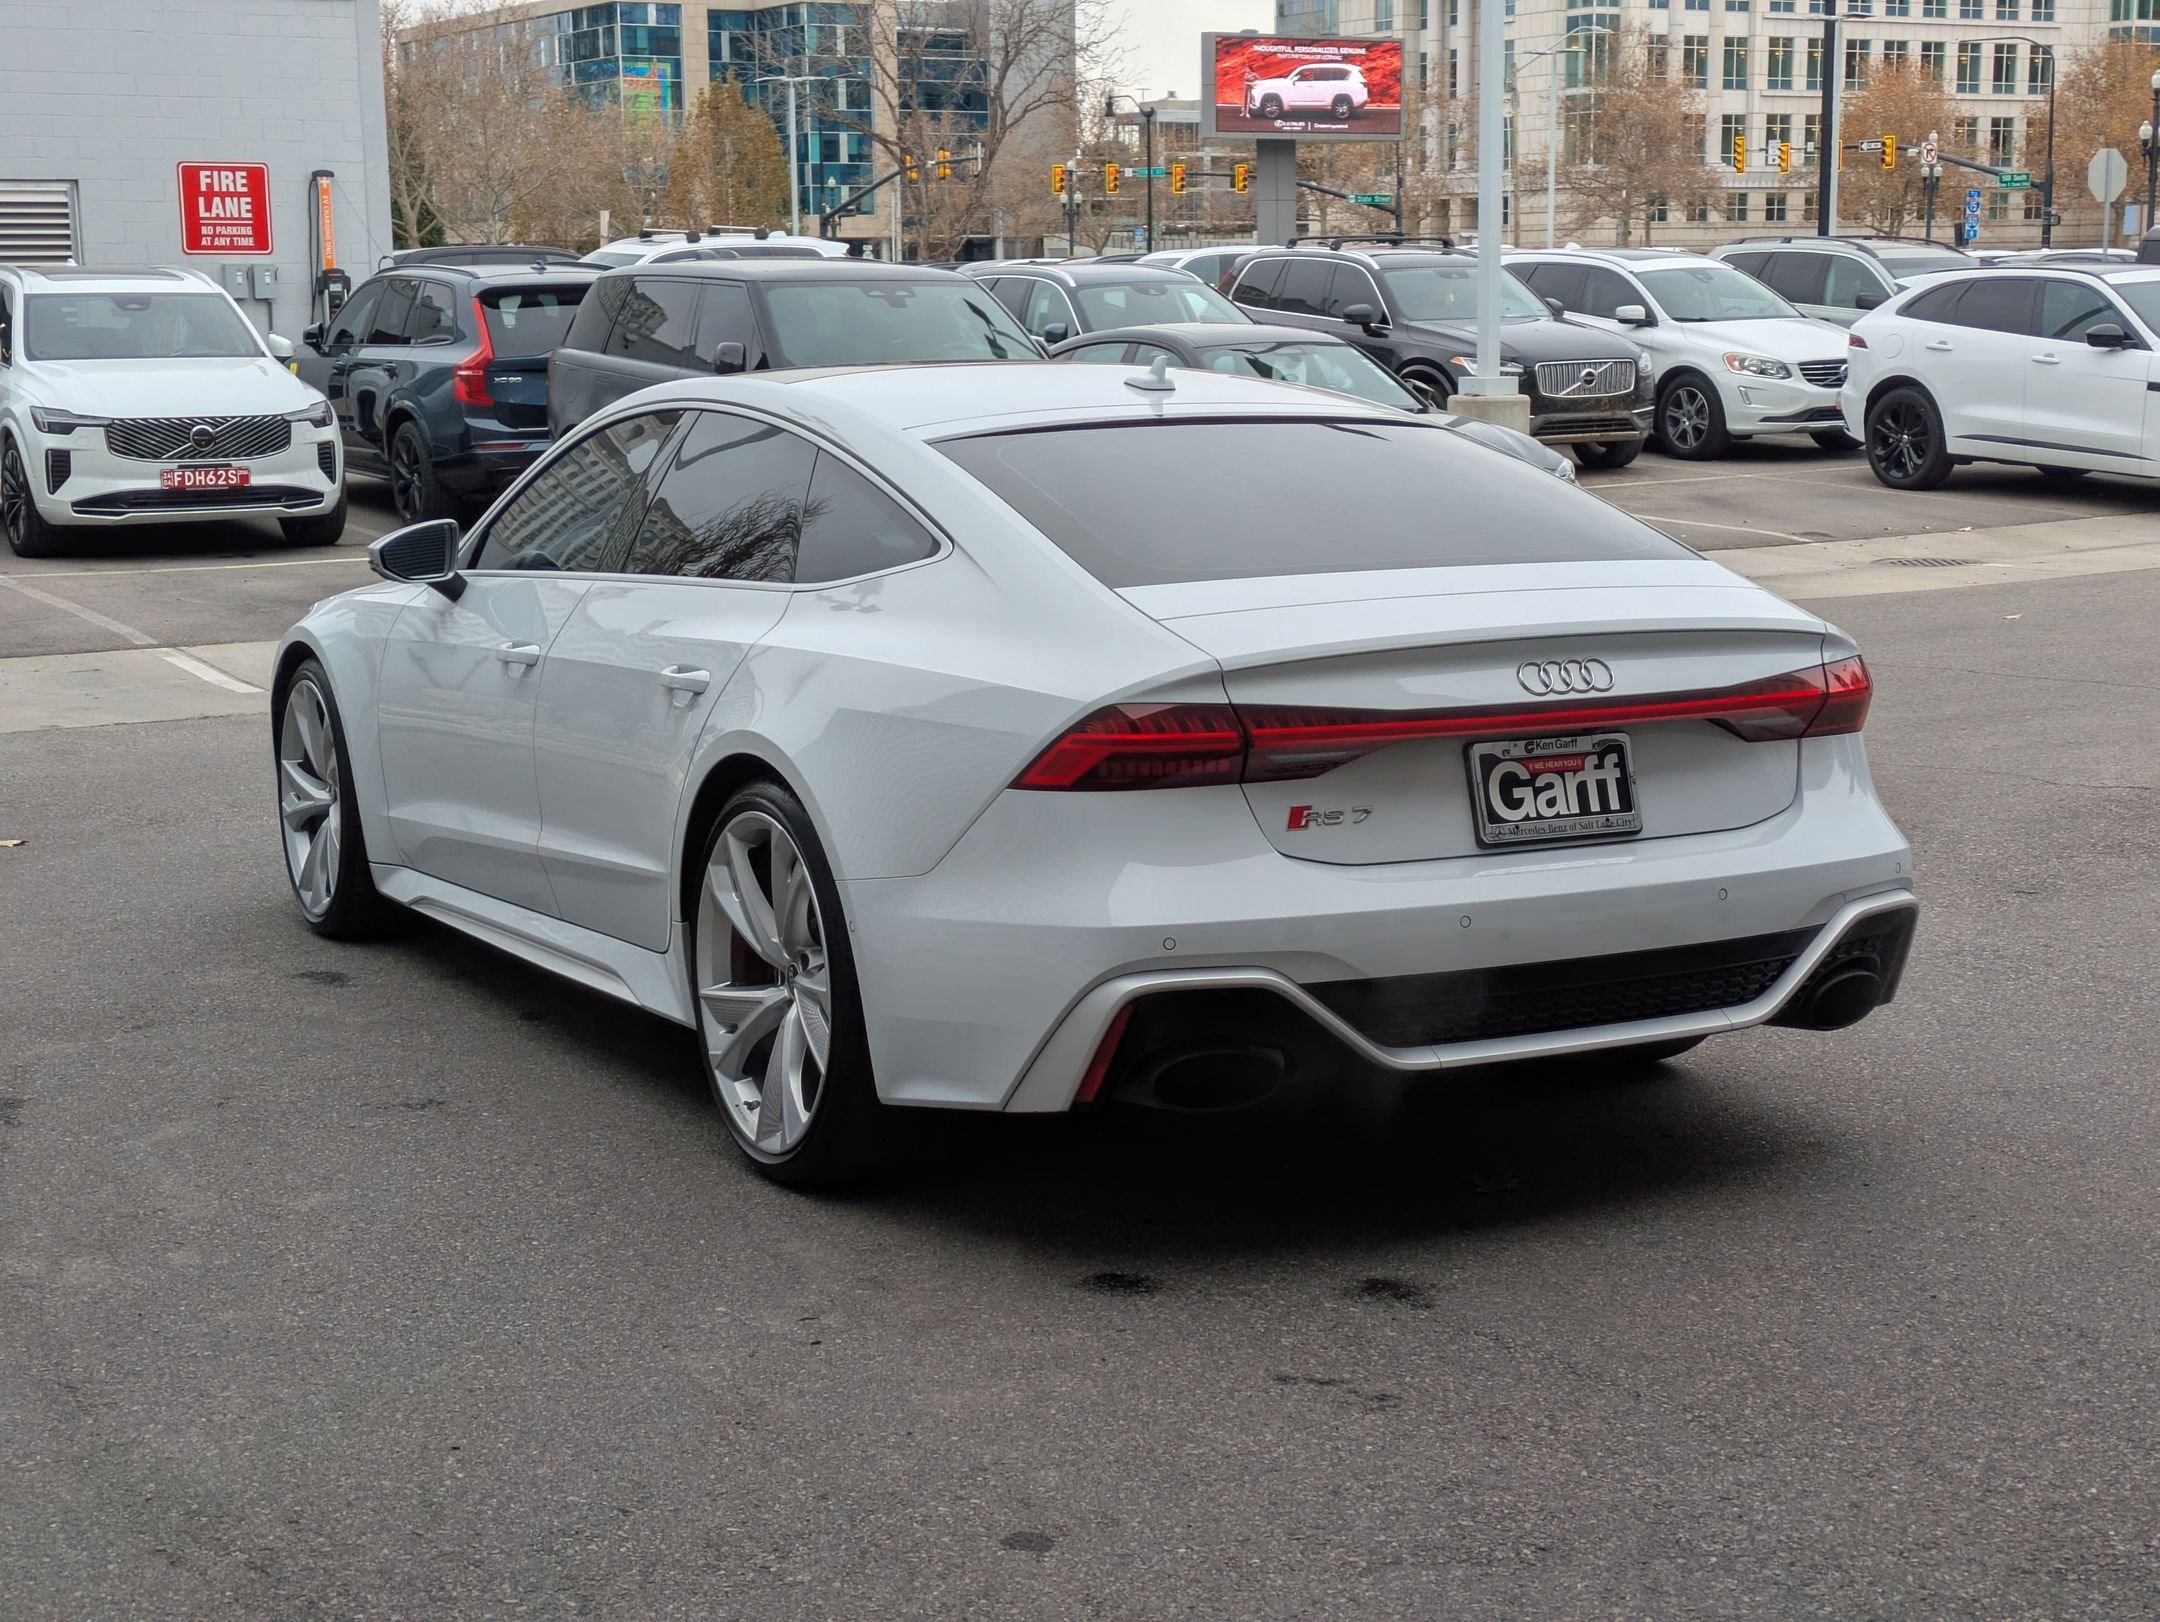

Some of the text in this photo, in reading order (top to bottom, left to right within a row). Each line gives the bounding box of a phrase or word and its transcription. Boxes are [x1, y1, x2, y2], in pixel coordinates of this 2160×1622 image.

[199, 170, 248, 192] FIRE
[198, 196, 253, 218] LANE
[201, 226, 253, 235] NO PARKING
[201, 237, 255, 246] AT ANY TIME
[325, 241, 333, 259] ONLY
[174, 470, 237, 487] FDH62S
[1535, 738, 1578, 750] Ken Garff
[1534, 759, 1577, 769] WE HEAR YOU
[1489, 752, 1621, 821] Garff
[1351, 805, 1374, 824] 7
[1569, 821, 1578, 831] of
[1578, 820, 1594, 830] Salt
[1595, 819, 1615, 828] Lake
[1616, 817, 1631, 828] City
